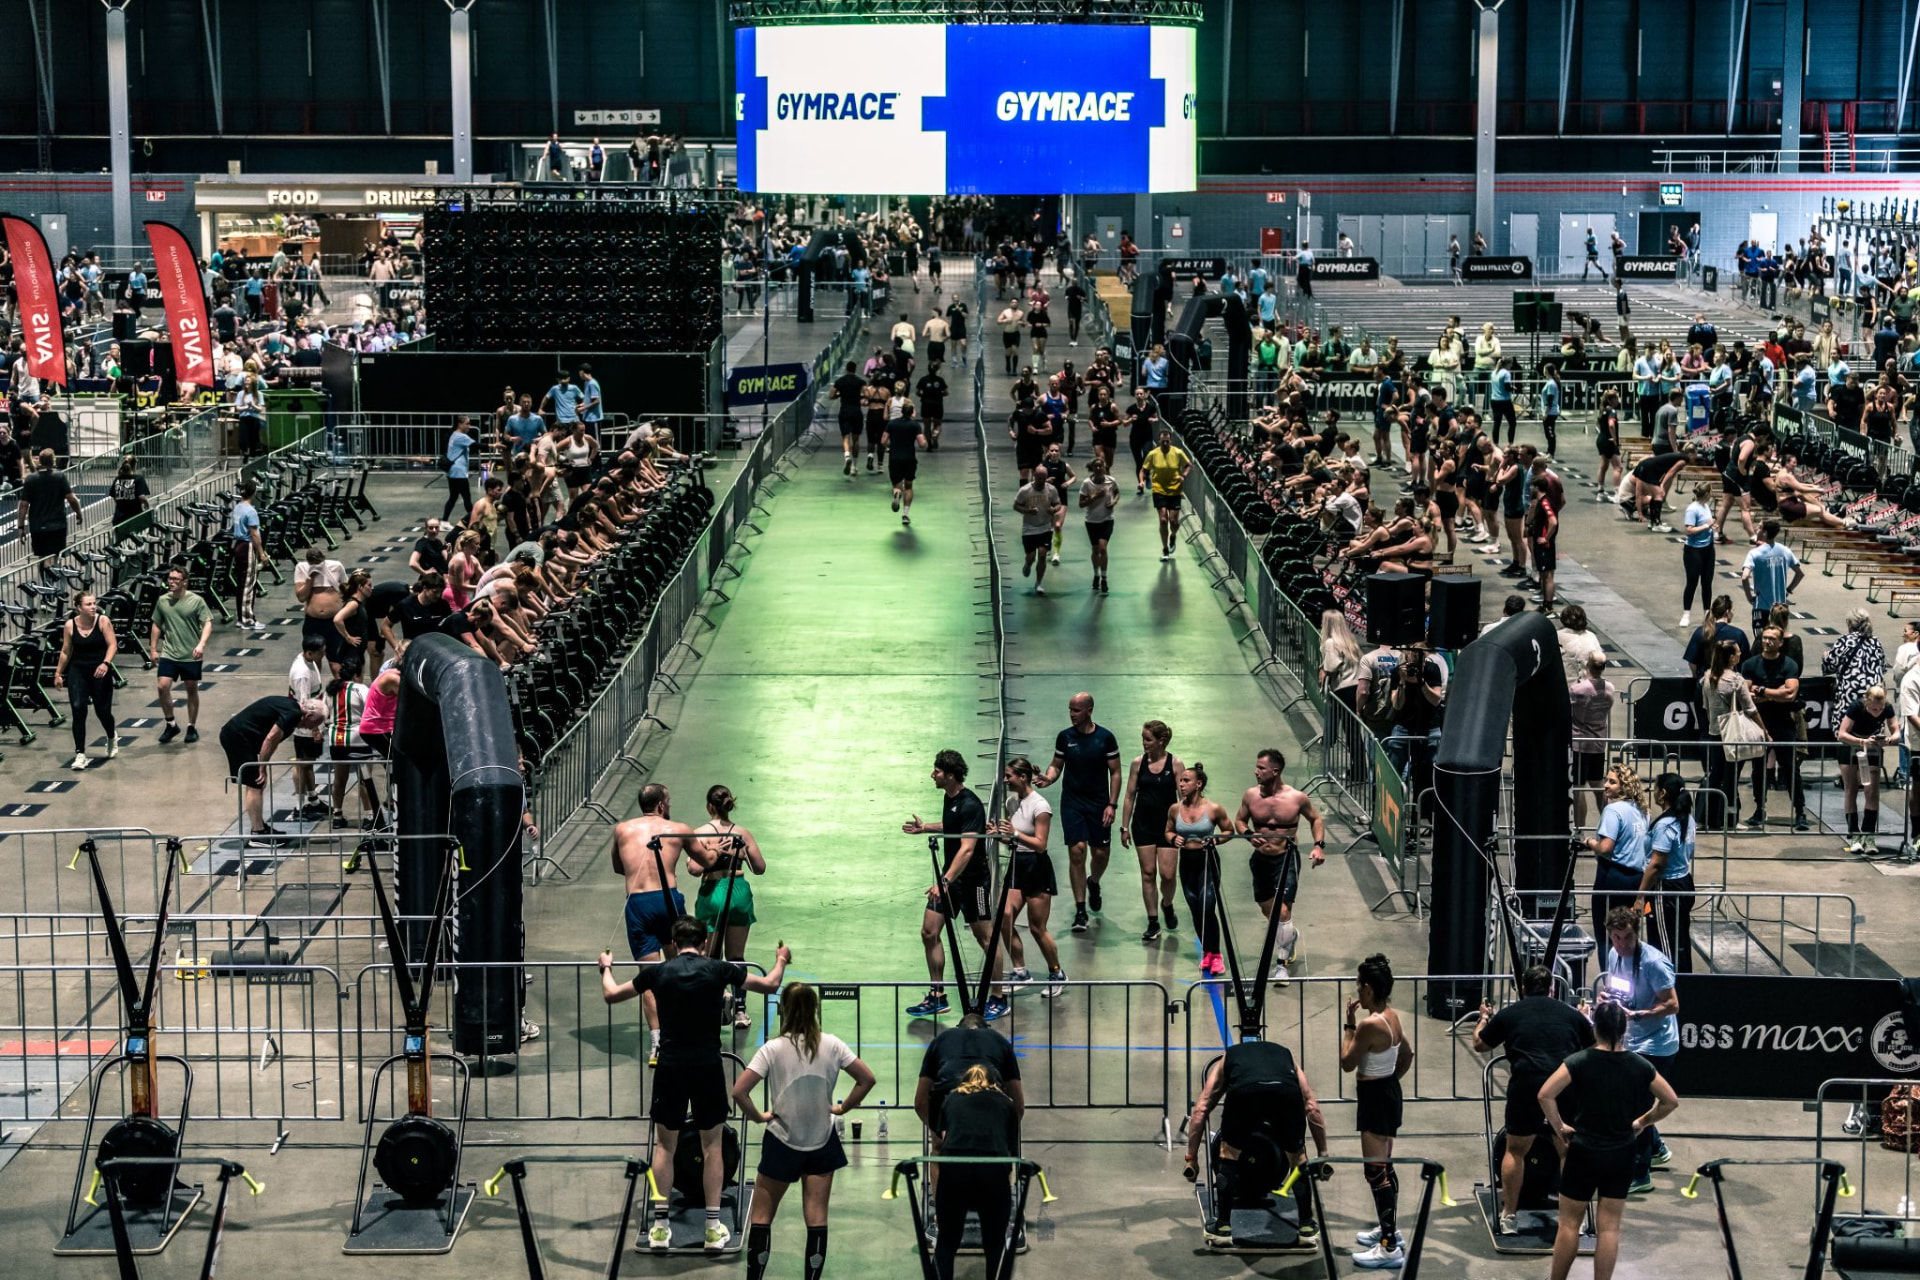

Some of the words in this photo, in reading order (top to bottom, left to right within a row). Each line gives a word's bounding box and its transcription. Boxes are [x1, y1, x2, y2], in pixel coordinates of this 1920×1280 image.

[777, 92, 898, 121] GYMRACE
[996, 91, 1133, 121] GYMRACE
[591, 113, 599, 121] 11
[619, 113, 629, 121] 10
[636, 113, 643, 121] 9
[267, 190, 319, 205] FOOD
[1316, 262, 1370, 273] GYMRACE
[1624, 262, 1677, 272] GYMRACE
[738, 374, 797, 394] GYMRACE
[1846, 497, 1877, 515] YMRACE
[1866, 507, 1898, 525] YMRACE
[1681, 1022, 1735, 1049] OSS
